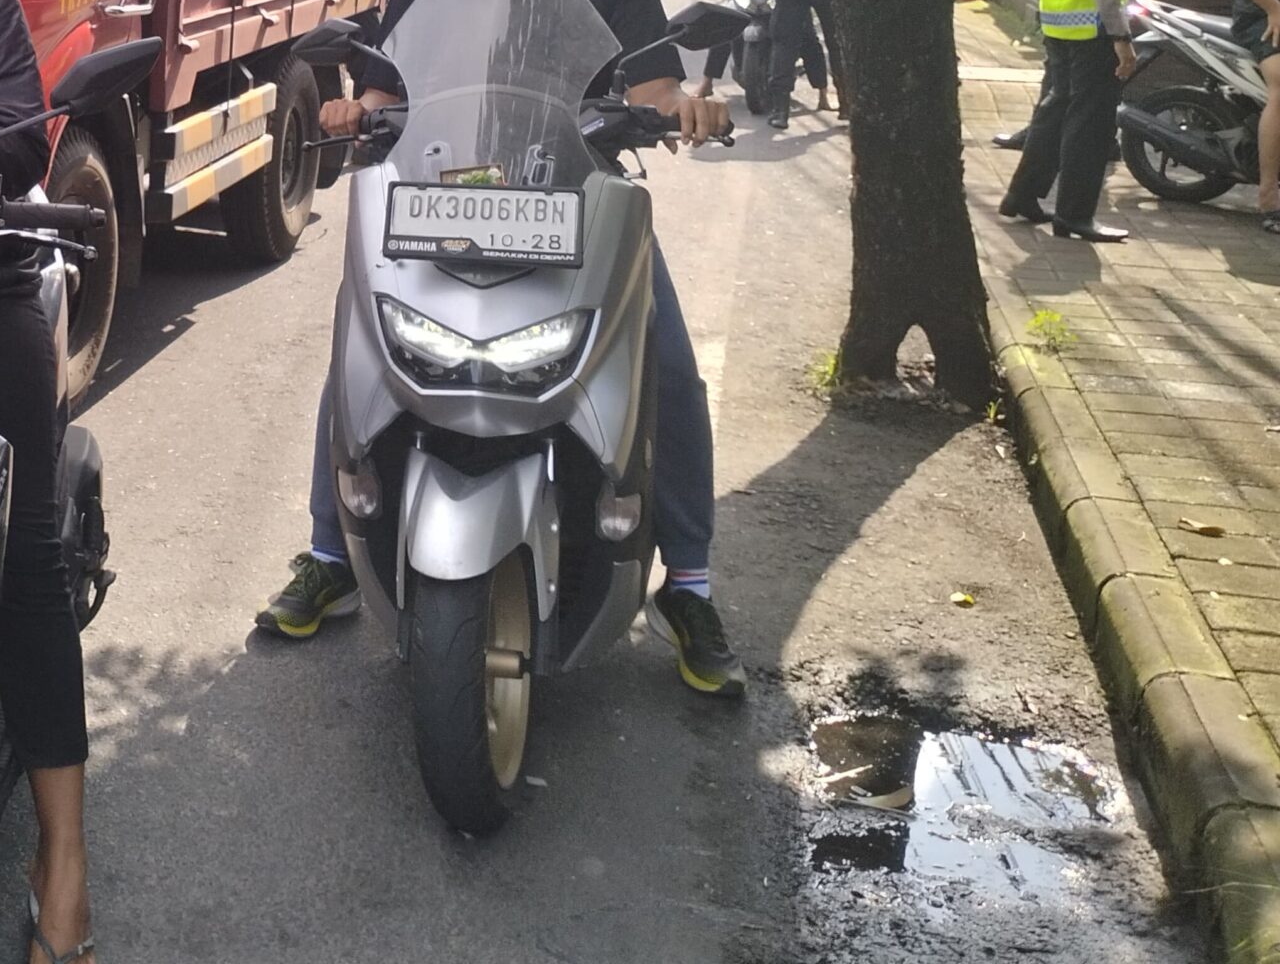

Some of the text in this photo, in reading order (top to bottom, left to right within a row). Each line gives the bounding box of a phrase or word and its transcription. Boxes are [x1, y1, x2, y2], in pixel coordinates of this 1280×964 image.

[399, 240, 437, 252] YAMAHA
[482, 250, 528, 259] SEMAKIN
[528, 252, 539, 260] DI
